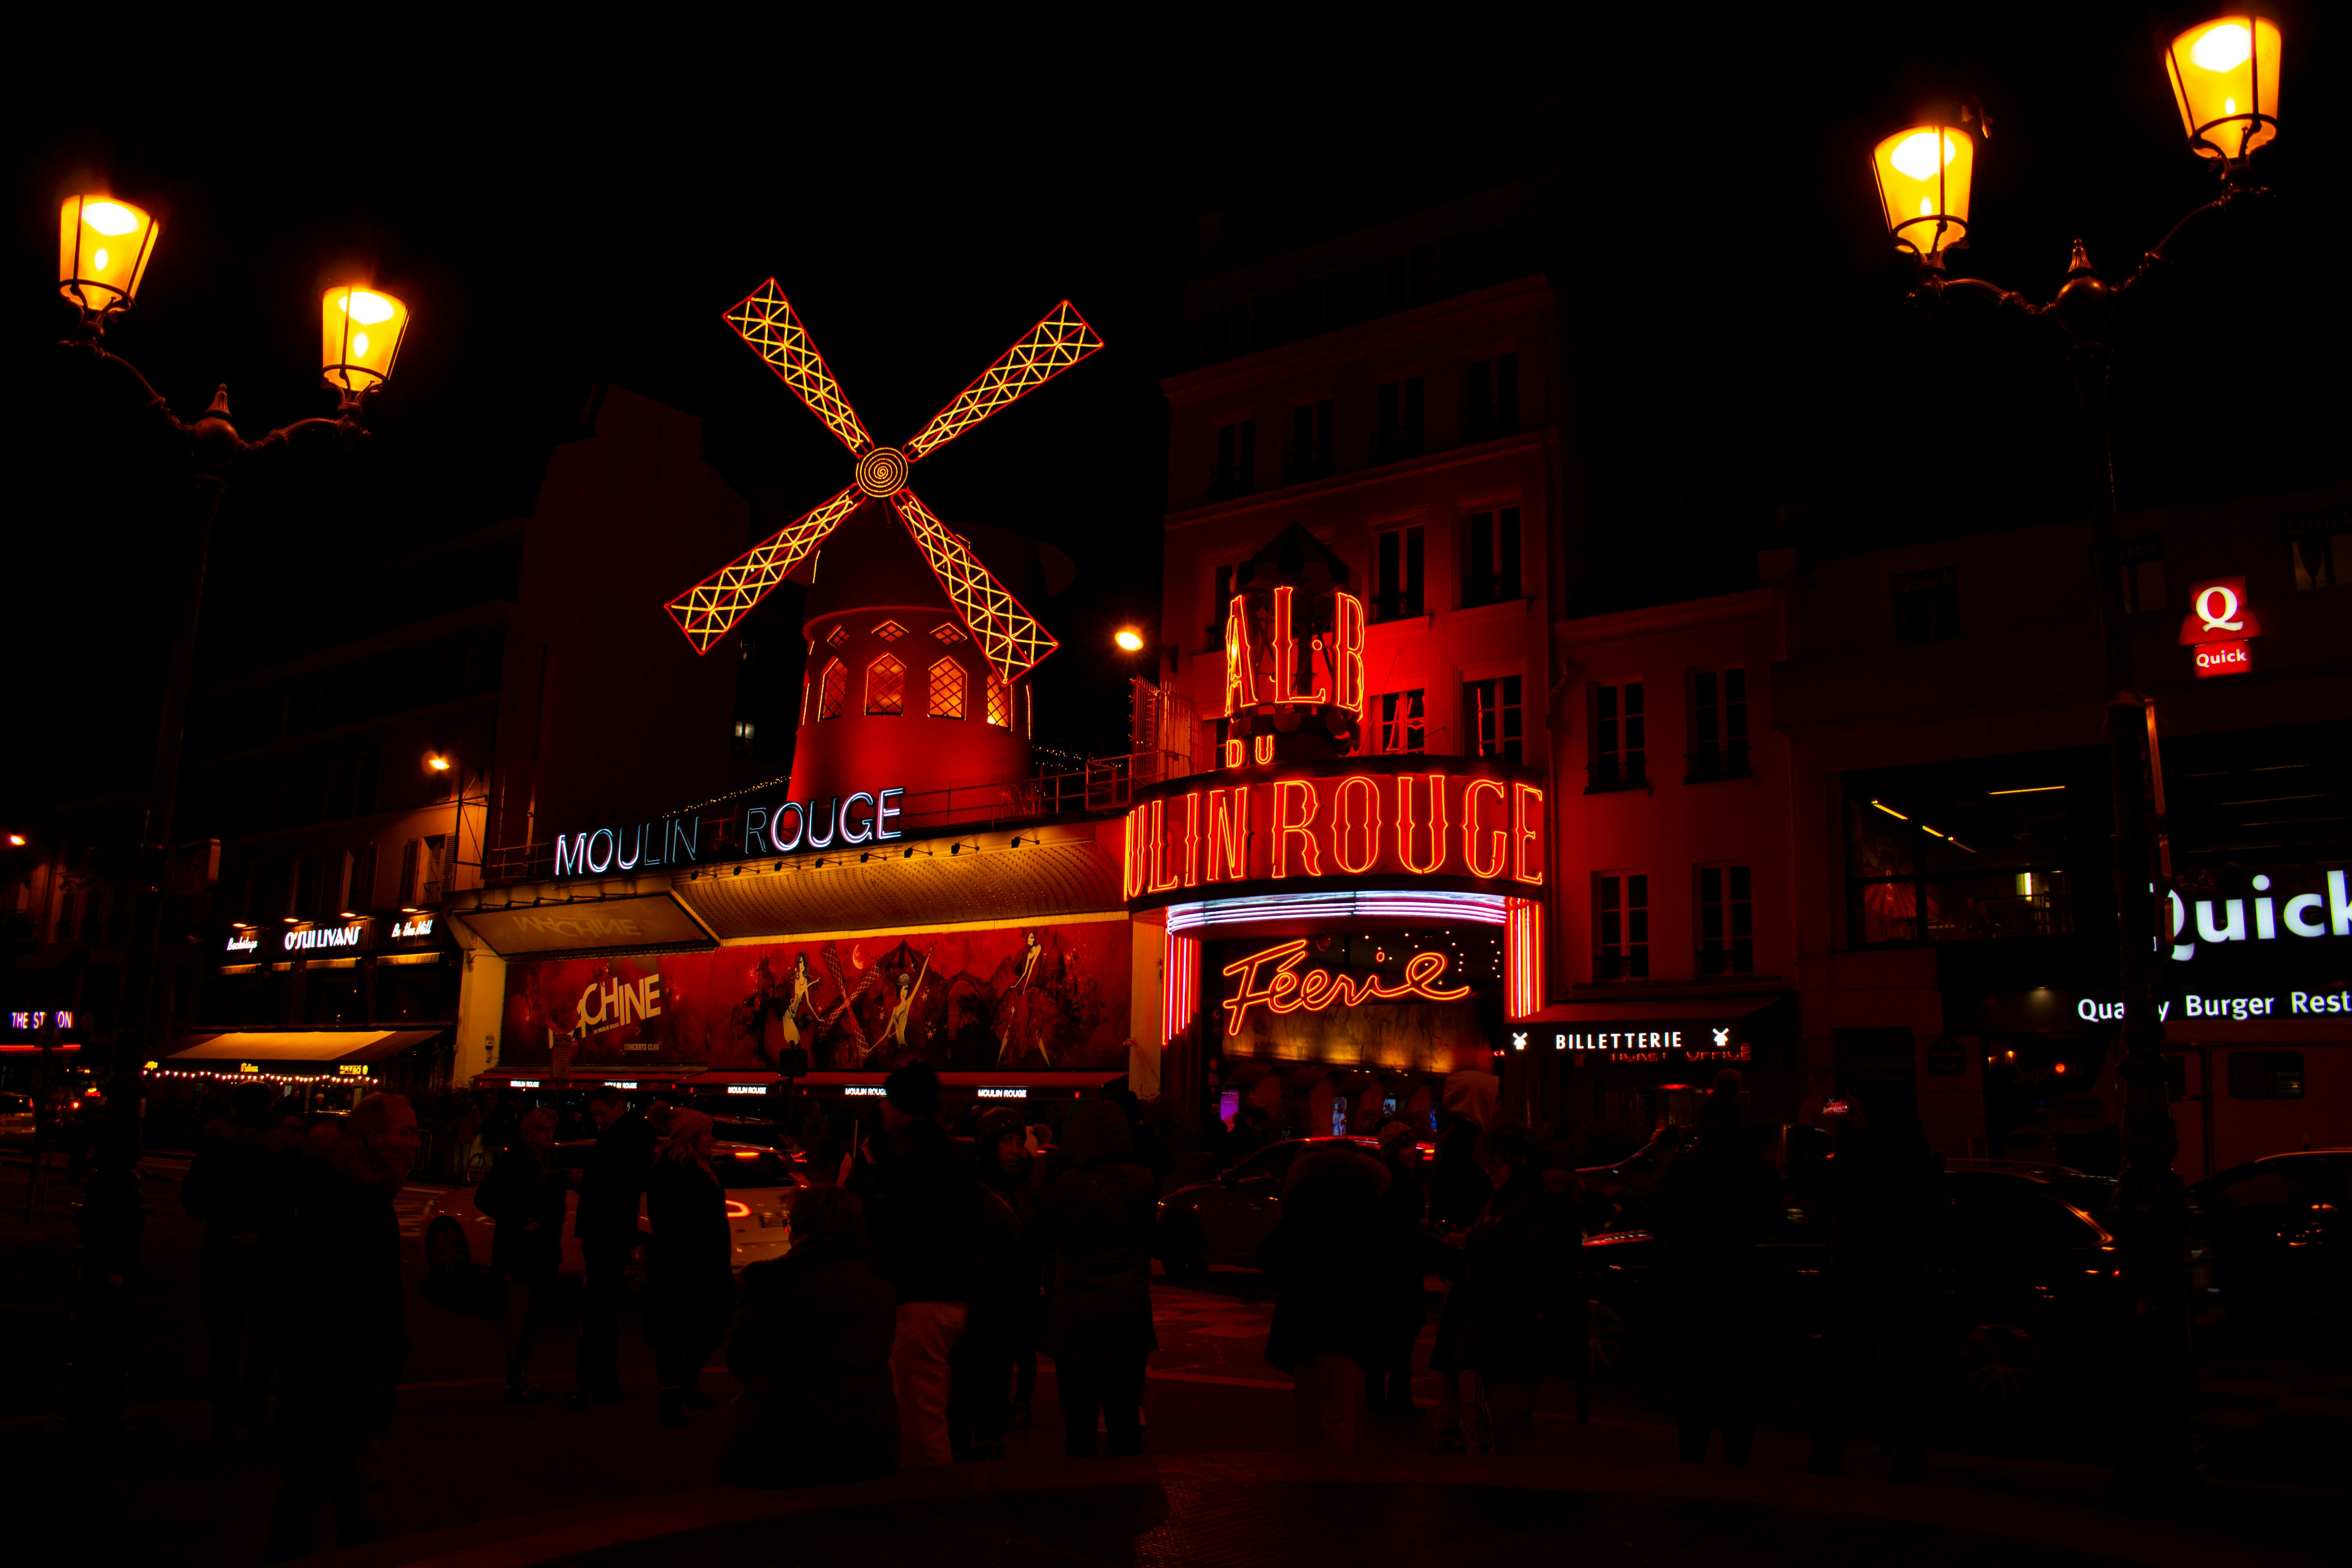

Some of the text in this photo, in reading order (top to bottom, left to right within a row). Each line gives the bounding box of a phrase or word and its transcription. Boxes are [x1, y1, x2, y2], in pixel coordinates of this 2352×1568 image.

[2196, 586, 2243, 632] Q
[2196, 649, 2247, 668] Quick
[1226, 735, 1273, 768] DU
[554, 787, 905, 876] MOULIN ROUGE
[1124, 775, 1543, 902] ULIN ROUGE
[403, 921, 415, 936] the
[415, 920, 432, 935] Mill
[227, 936, 258, 953] Backstage
[1222, 938, 1472, 1036] Féerie
[2078, 990, 2352, 1022] Quay Burger Rest
[12, 1012, 29, 1029] THE
[1555, 1031, 1682, 1050] BILLETTERIE
[978, 1089, 1027, 1098] MOULIN ROUGE
